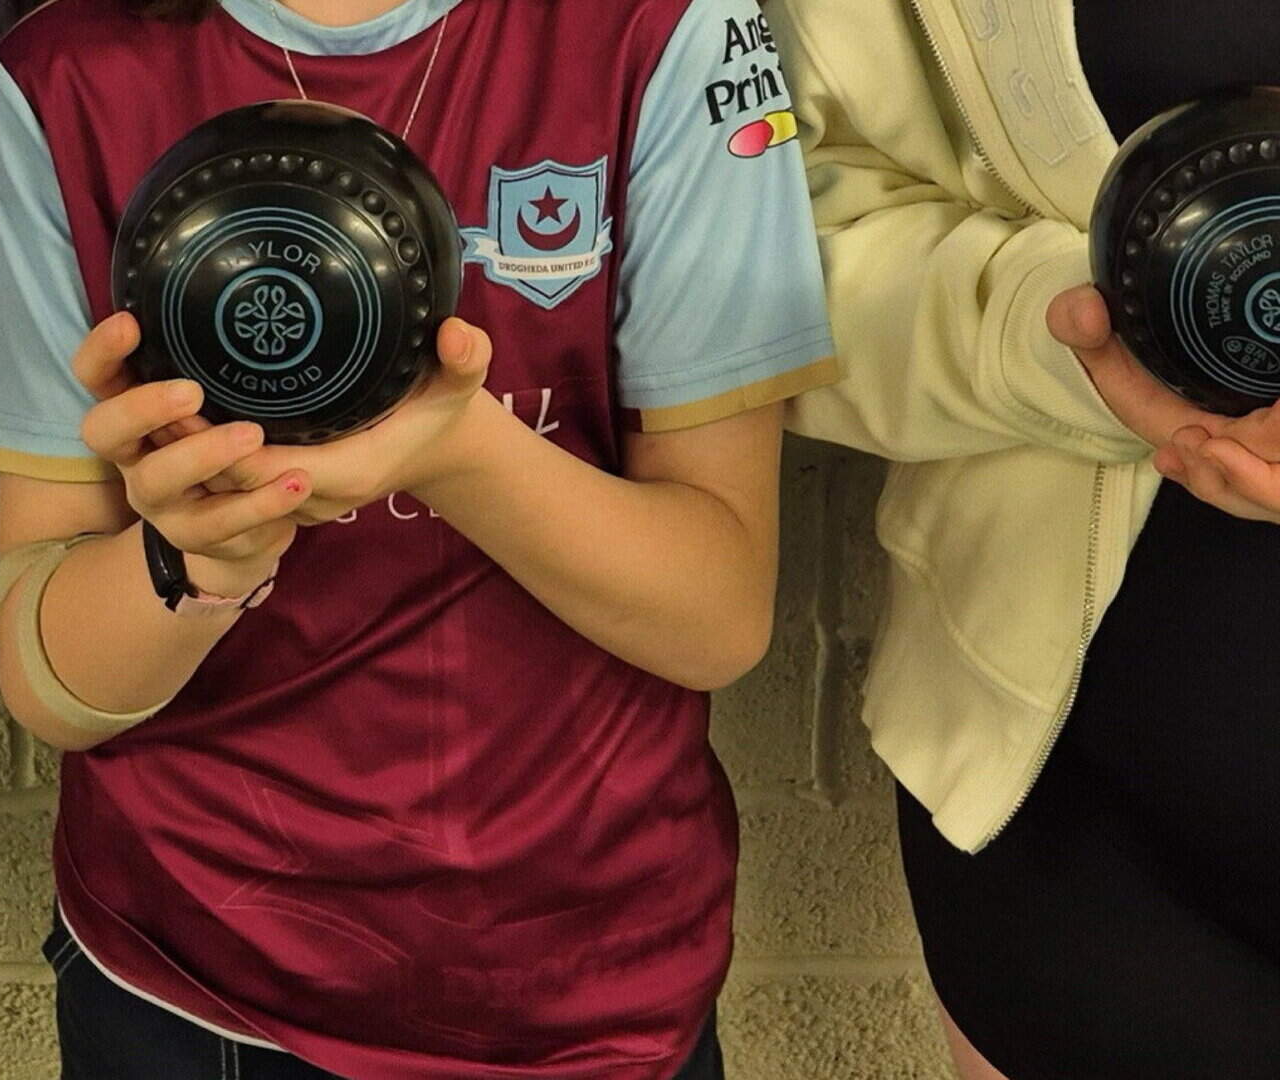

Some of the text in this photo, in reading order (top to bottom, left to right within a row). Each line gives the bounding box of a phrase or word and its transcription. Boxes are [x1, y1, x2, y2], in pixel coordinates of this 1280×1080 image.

[705, 62, 783, 126] Prin
[234, 241, 321, 274] YLOR
[551, 261, 584, 273] UNITED
[1206, 234, 1274, 328] THOMAS TAYLOR
[219, 362, 323, 393] LIGNOID
